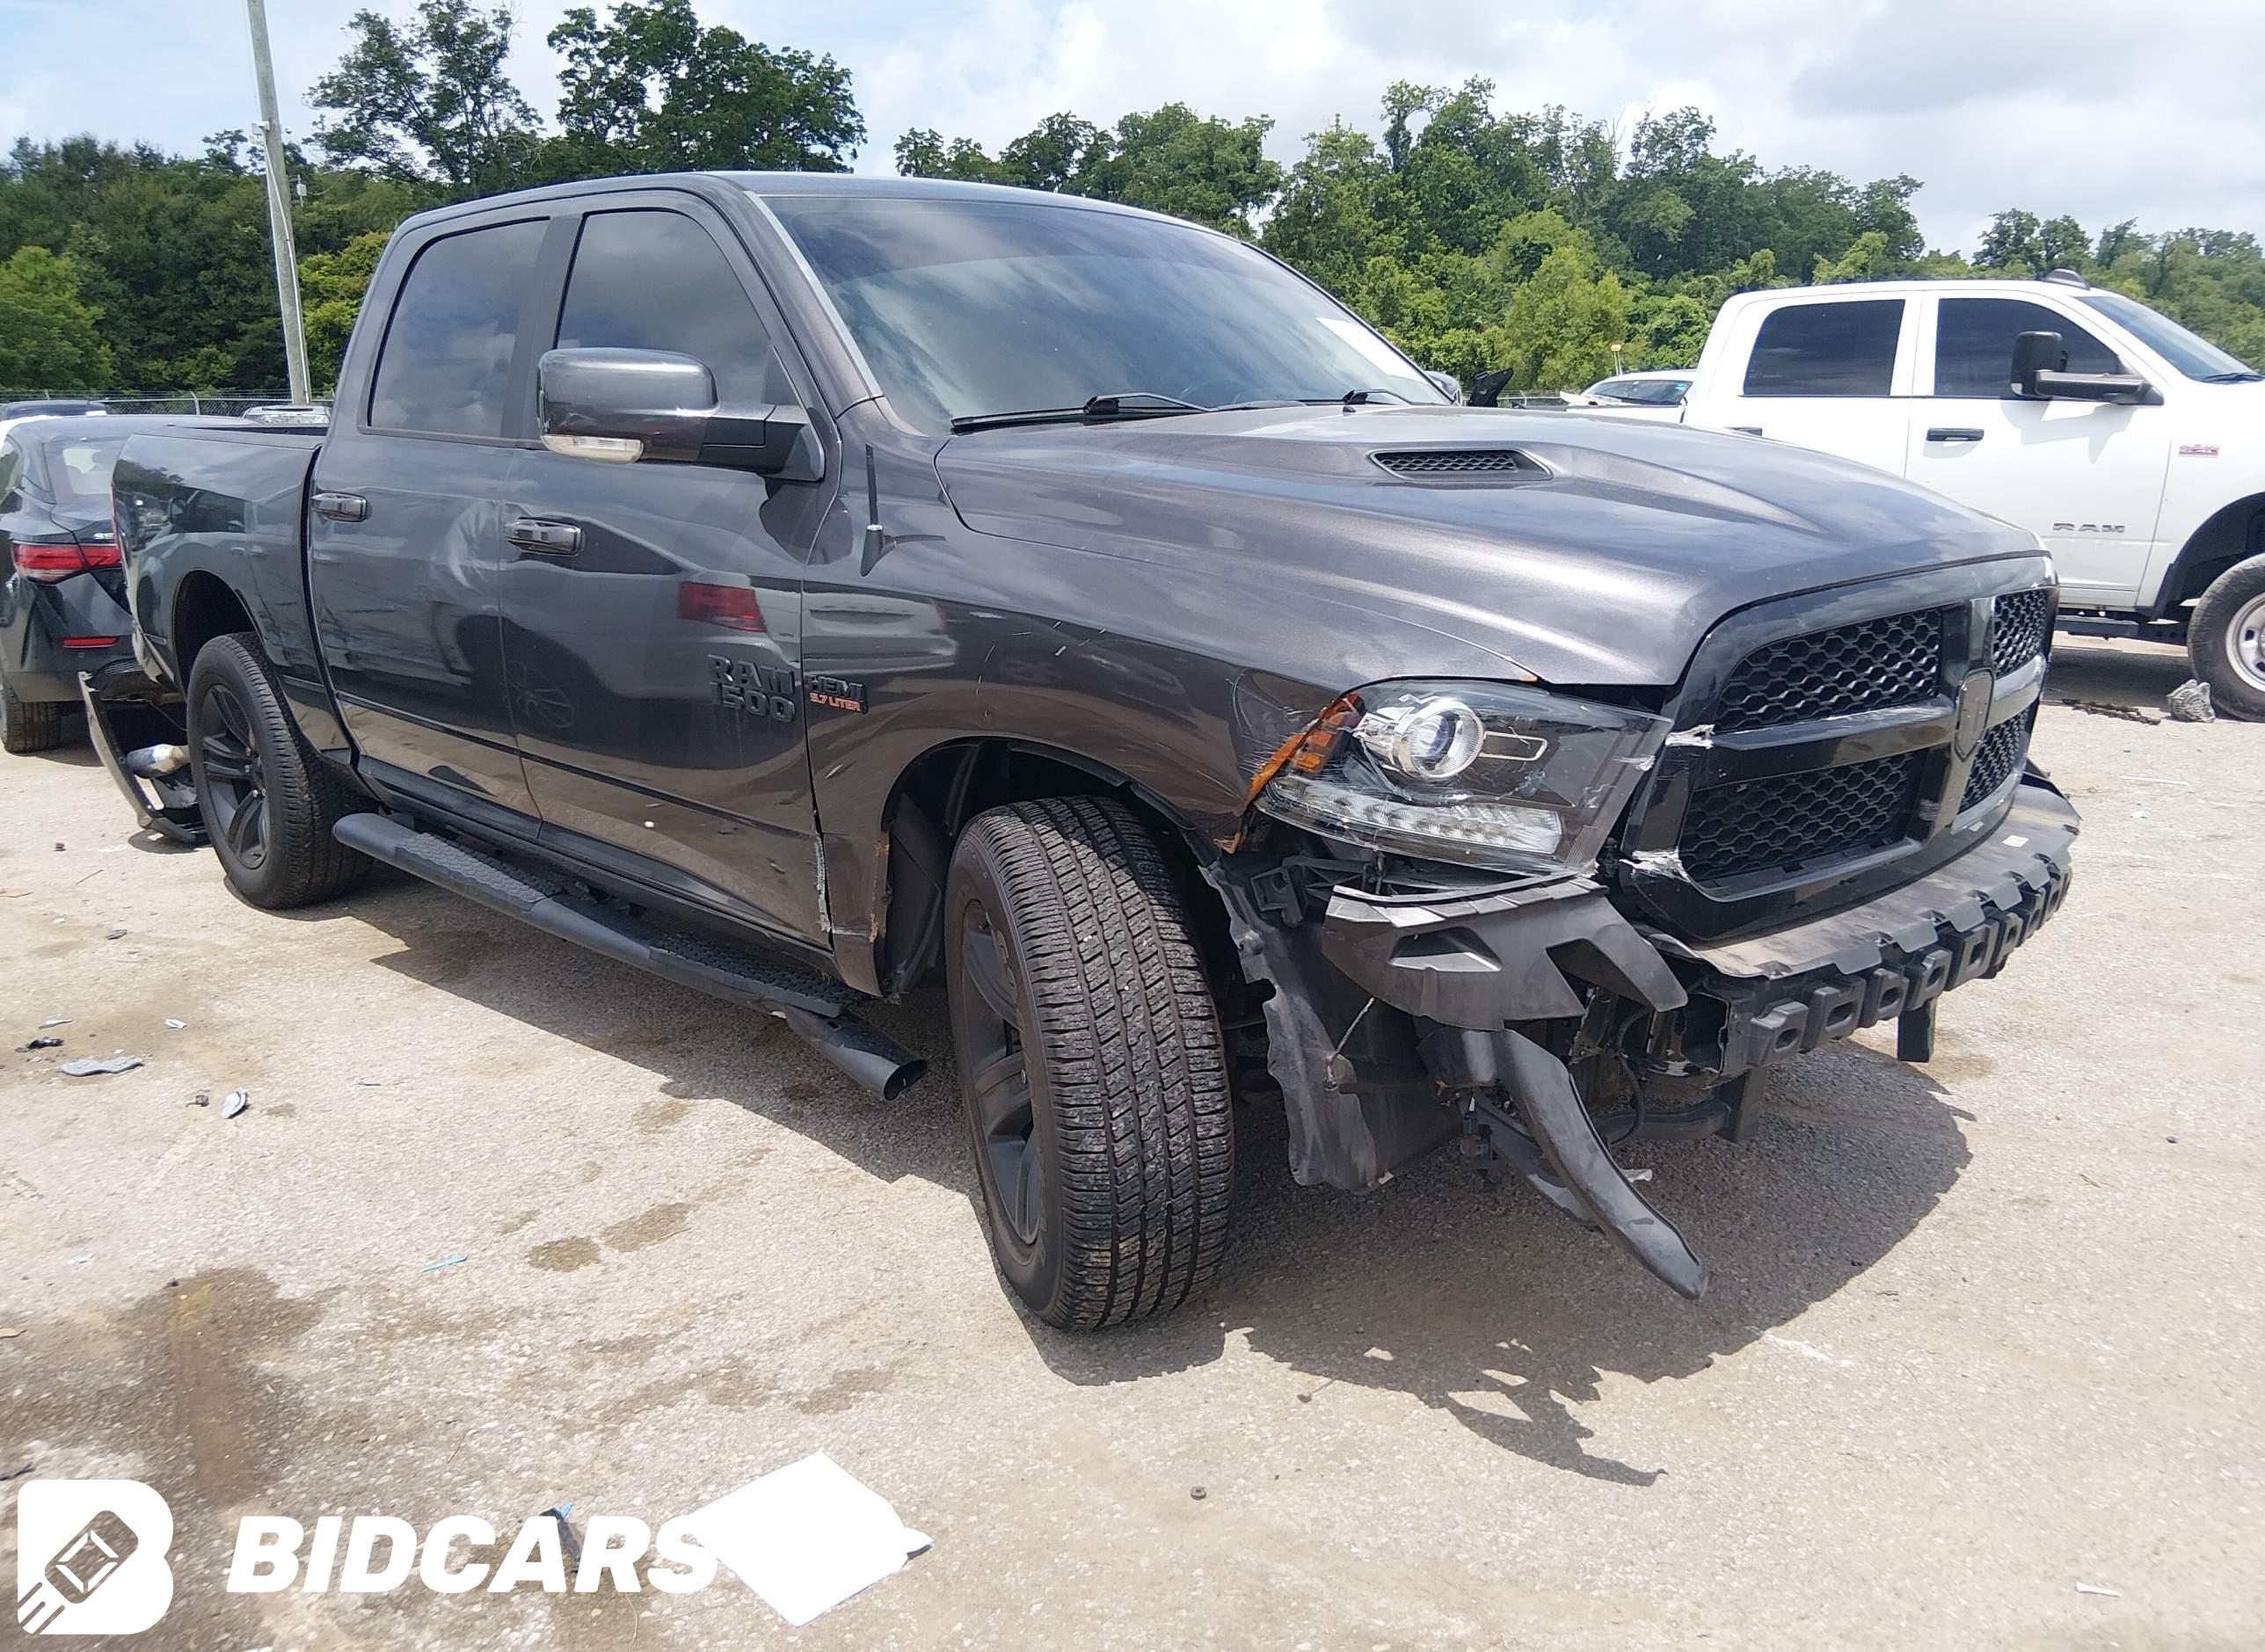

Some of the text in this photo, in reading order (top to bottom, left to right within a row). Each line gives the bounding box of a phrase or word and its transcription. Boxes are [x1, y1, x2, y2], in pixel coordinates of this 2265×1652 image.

[2052, 522, 2125, 533] RAM
[707, 653, 796, 695] RAM
[809, 674, 866, 700] HEMI
